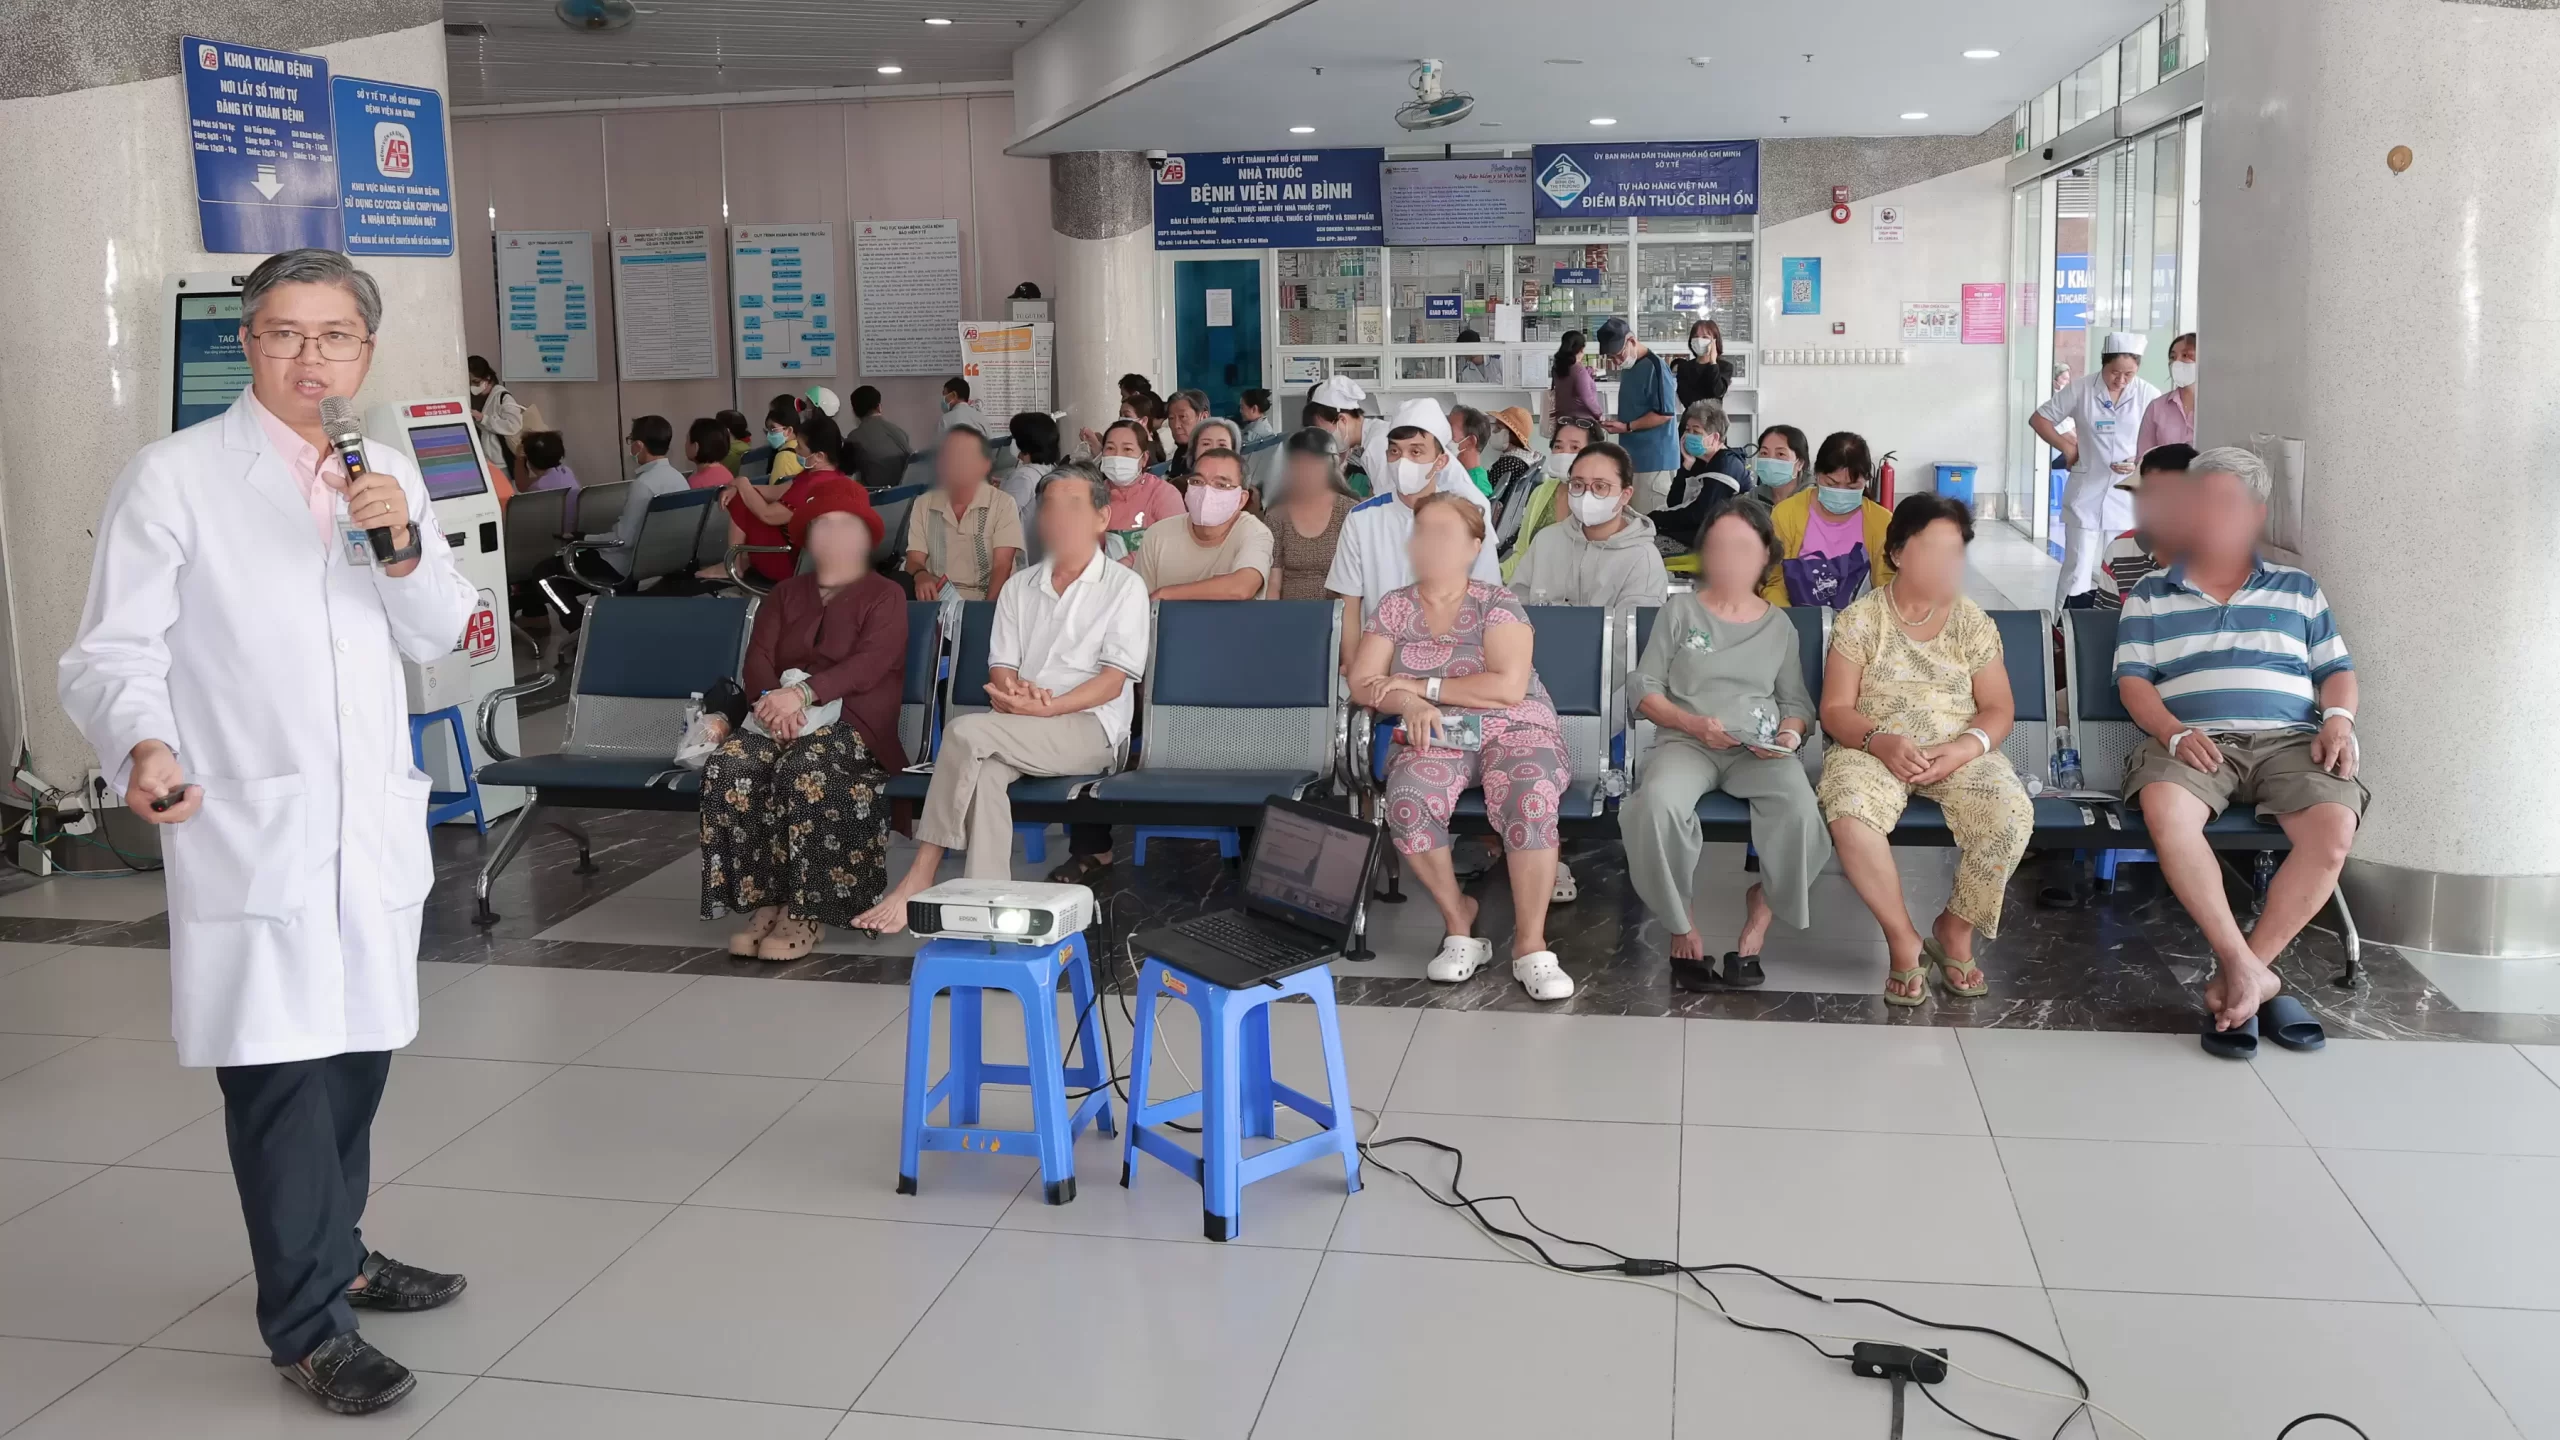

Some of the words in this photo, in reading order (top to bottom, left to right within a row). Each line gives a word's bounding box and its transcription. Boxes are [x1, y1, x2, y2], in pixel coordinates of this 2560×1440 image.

[224, 52, 252, 70] KHOA
[254, 56, 284, 74] KHÁM
[287, 60, 313, 79] BỆNH
[220, 80, 236, 92] NƠI
[238, 78, 253, 96] LẤY
[256, 81, 267, 98] SỐ
[269, 85, 286, 100] THỨ
[287, 88, 298, 104] TỰ
[357, 88, 364, 99] SỞ
[371, 90, 378, 100] TẾ
[389, 93, 397, 103] HỒ
[216, 98, 240, 115] ĐĂNG
[242, 102, 253, 117] KÝ
[256, 104, 280, 120] KHÁM
[282, 106, 304, 124] BỆNH
[365, 103, 380, 114] BỆNH
[381, 105, 394, 116] VIỆN
[395, 109, 402, 117] AN
[403, 110, 415, 118] BÌNH
[385, 139, 409, 168] AB
[1222, 155, 1231, 164] SỞ
[1237, 155, 1244, 164] TẾ
[1246, 155, 1265, 164] THÀNH
[1267, 153, 1279, 163] PHỐ
[1280, 153, 1289, 162] HỒ
[1290, 153, 1300, 162] CHÍ
[1594, 152, 1603, 160] ỦY
[1682, 150, 1696, 158] PHỐ
[1698, 150, 1708, 158] HỒ
[1238, 166, 1262, 179] NHÀ
[1265, 163, 1303, 179] THUỐC
[1655, 160, 1664, 168] SỞ
[1672, 160, 1680, 168] TẾ
[1162, 165, 1183, 179] AB
[352, 182, 364, 191] KHU
[366, 182, 378, 194] VỰC
[380, 183, 396, 193] ĐĂNG
[397, 184, 405, 194] KÝ
[407, 185, 424, 195] KHÁM
[424, 186, 440, 196] BỆNH
[1191, 183, 1234, 205] BỆNH
[1240, 182, 1277, 204] VIỆN
[1283, 183, 1306, 200] AN
[1312, 180, 1352, 199] BÌNH
[1618, 183, 1630, 192] TỰ
[1632, 182, 1650, 190] HÀO
[1652, 182, 1676, 190] HÀNG
[1678, 181, 1696, 191] VIỆT
[345, 194, 354, 208] SỬ
[356, 199, 373, 210] DỤNG
[374, 199, 401, 210] CC/CCCD
[403, 198, 415, 210] GẮN
[1582, 192, 1615, 208] ĐIỂM
[1620, 193, 1646, 207] BÁN
[1649, 191, 1695, 206] THUỐC
[1699, 192, 1730, 205] BÌNH
[1734, 190, 1753, 205] ỔN
[1212, 206, 1222, 214] ĐẠT
[1224, 204, 1242, 213] CHUẨN
[1243, 206, 1256, 214] THỰC
[1258, 204, 1272, 213] HÀNH
[1274, 203, 1283, 211] TỐT
[1285, 203, 1296, 211] NHÀ
[1297, 202, 1314, 211] THUỐC
[361, 214, 366, 224] &
[368, 212, 385, 226] NHẬN
[386, 213, 401, 226] DIỆN
[402, 214, 423, 226] KHUÔN
[424, 215, 436, 229] MẶT
[1190, 216, 1207, 224] THUỐC
[1238, 214, 1254, 223] THUỐC
[1286, 213, 1303, 222] THUỐC
[1358, 212, 1374, 220] PHẨM
[1444, 299, 1454, 307] VỰC
[964, 330, 978, 339] AB
[464, 610, 495, 650] AB
